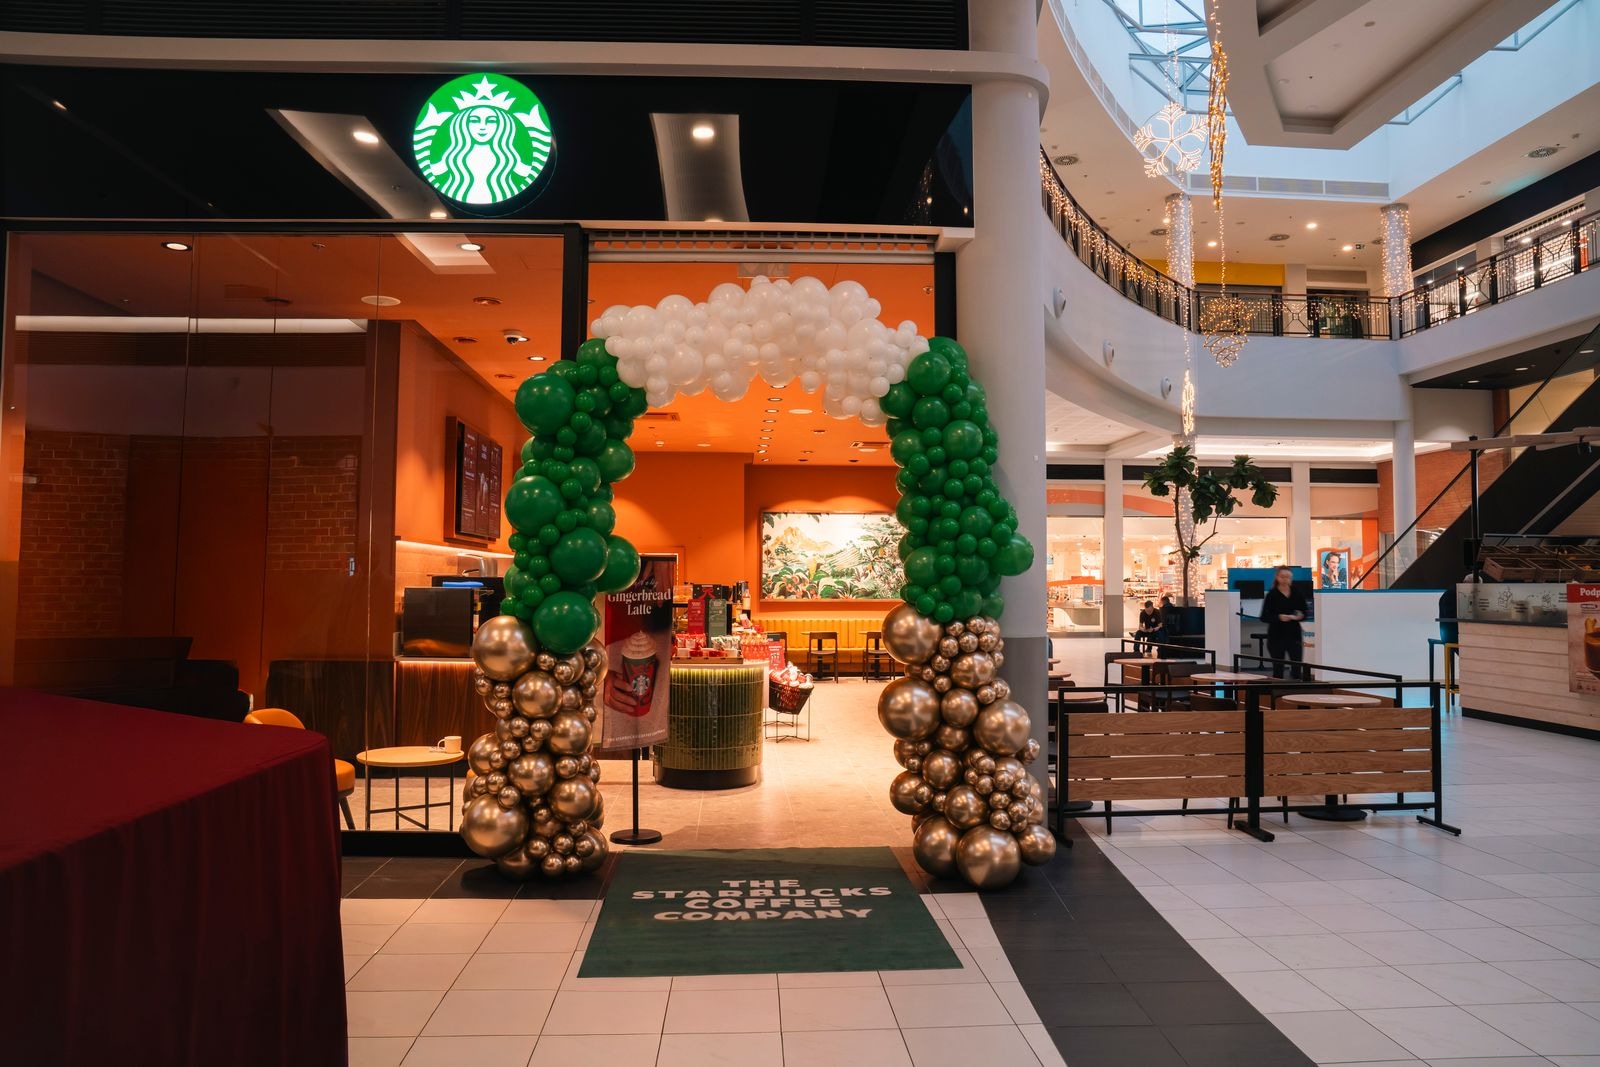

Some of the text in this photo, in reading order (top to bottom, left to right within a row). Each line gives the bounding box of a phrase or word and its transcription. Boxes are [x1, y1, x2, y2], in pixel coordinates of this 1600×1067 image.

[607, 588, 671, 604] Gingerbread
[627, 604, 652, 616] Latte
[722, 879, 801, 888] THE
[631, 887, 893, 900] STARBUCKS
[684, 898, 843, 909] COFFEE
[653, 908, 873, 921] COMPANY
